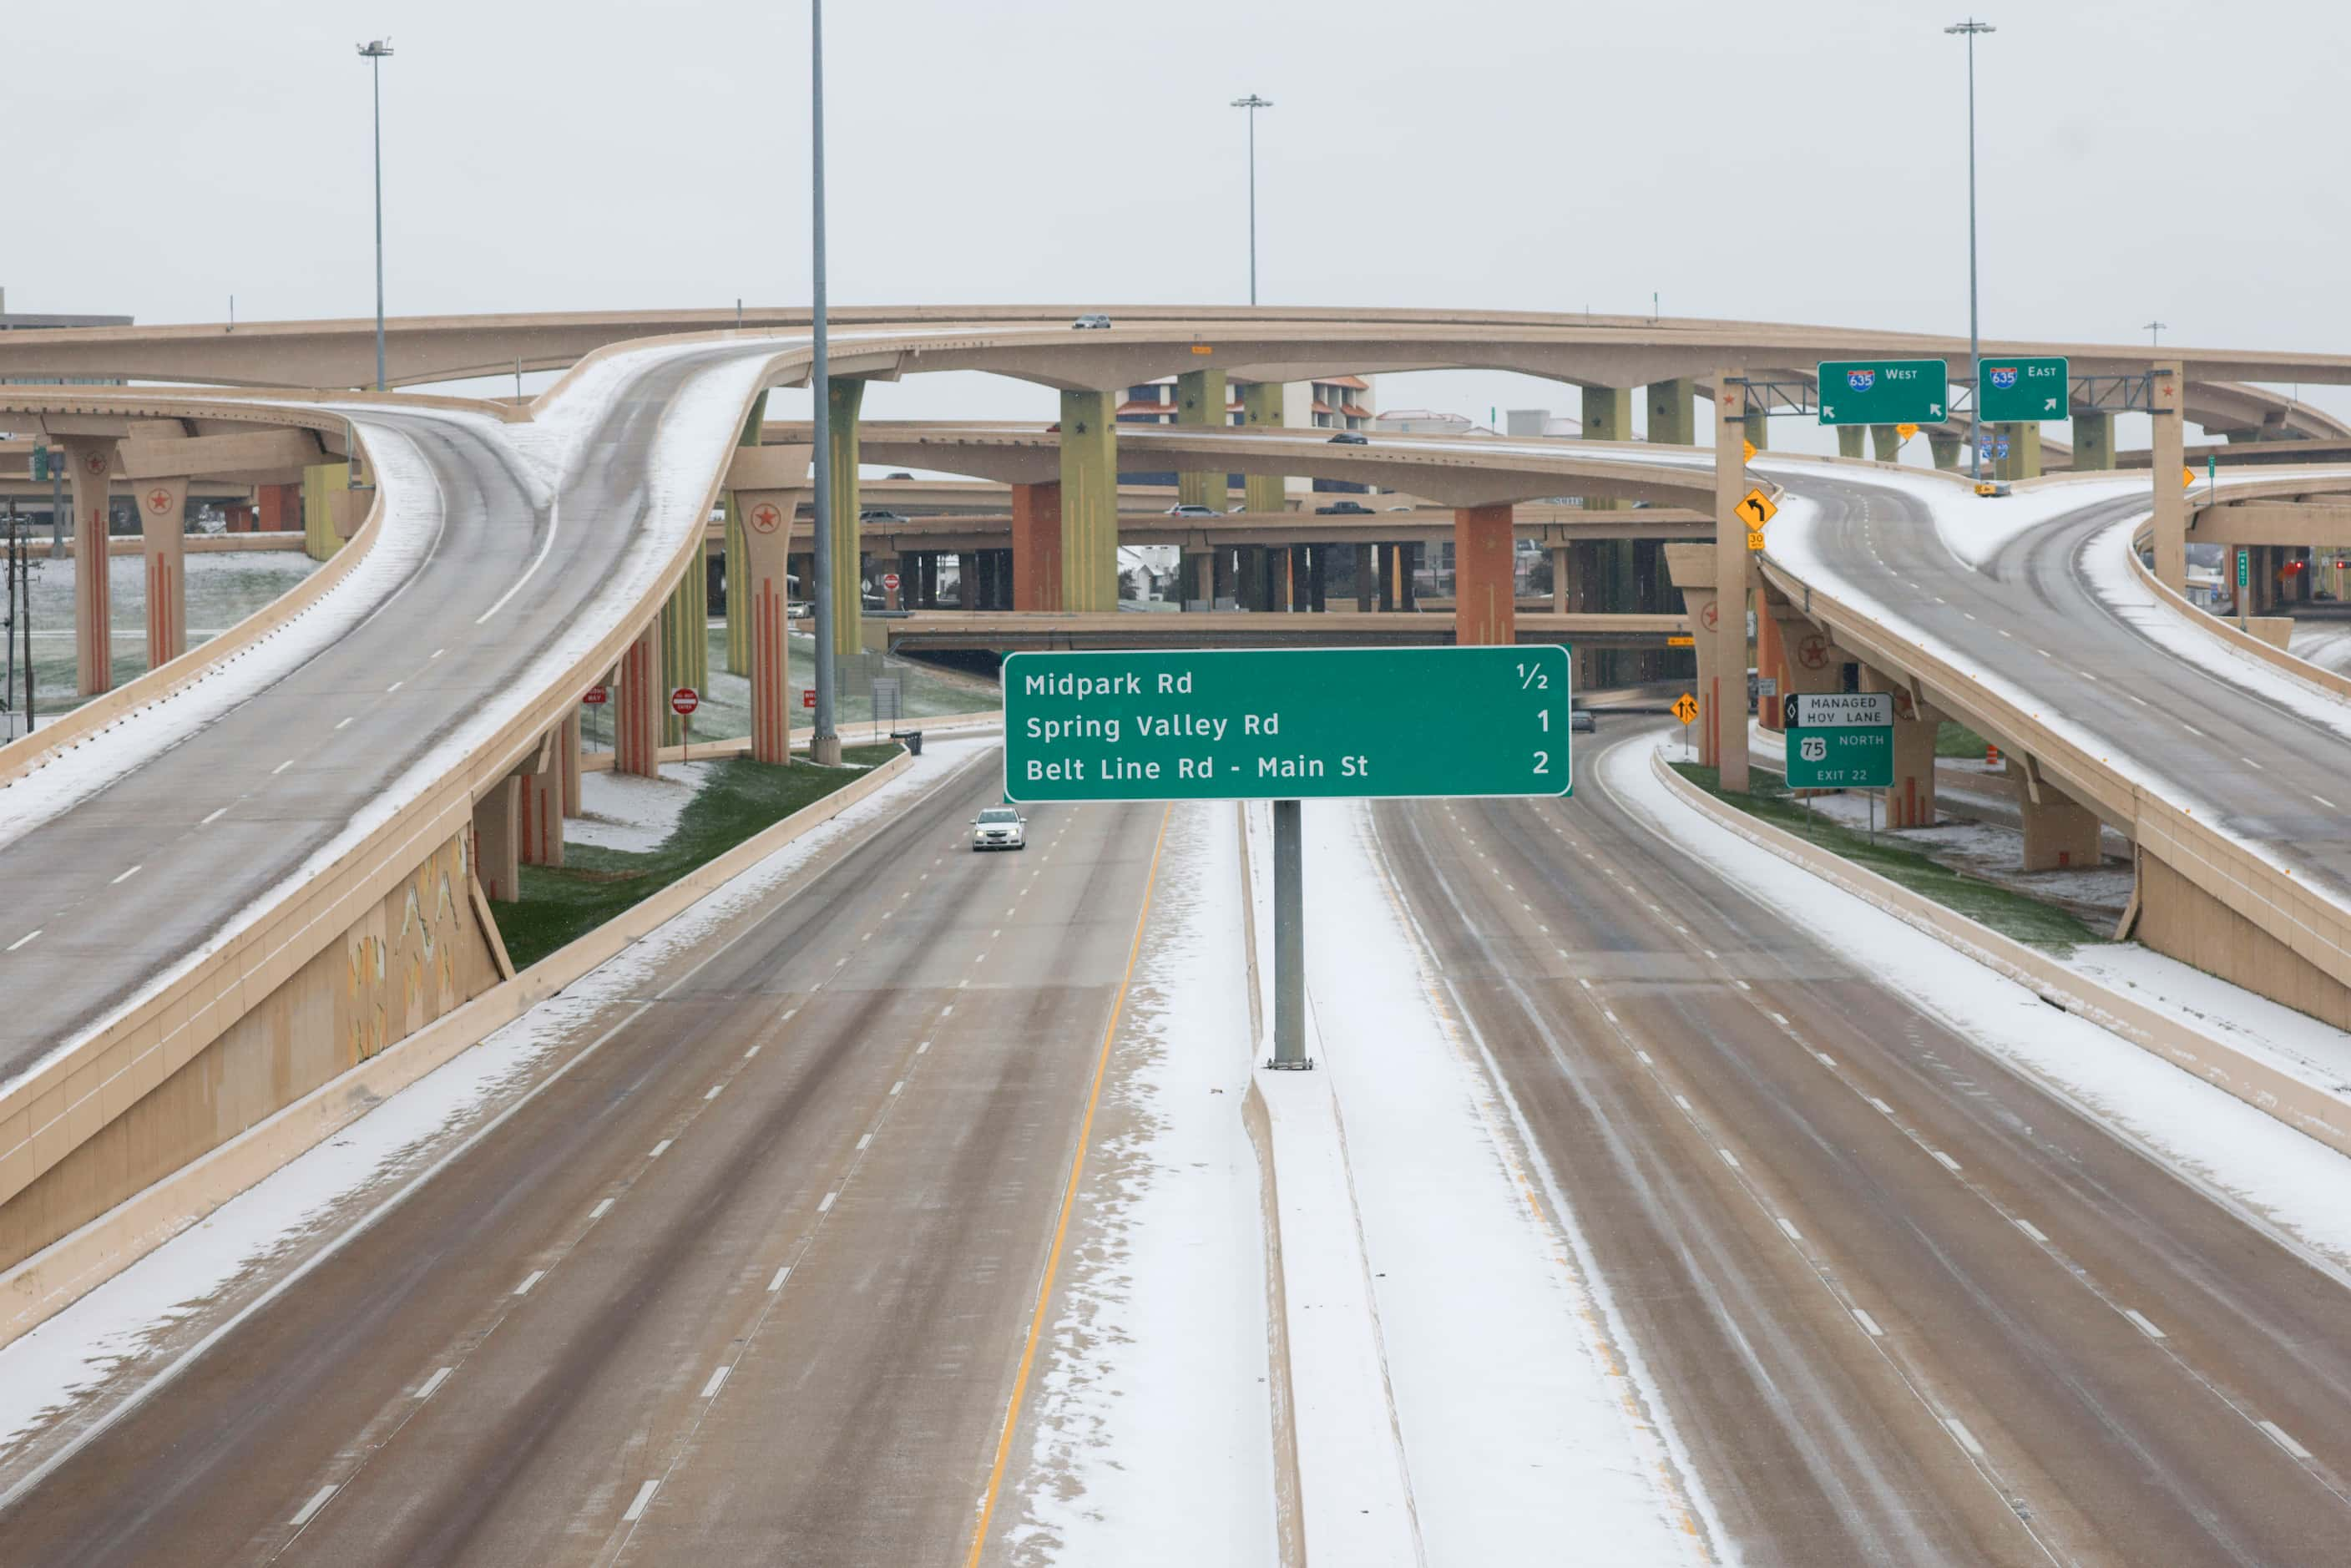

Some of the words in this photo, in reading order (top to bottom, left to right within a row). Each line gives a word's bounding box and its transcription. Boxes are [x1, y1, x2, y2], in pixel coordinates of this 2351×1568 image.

[1885, 368, 1918, 380] WEST
[1992, 372, 2015, 383] 635
[2028, 366, 2056, 377] EAST
[1850, 374, 1872, 386] 635
[1750, 534, 1763, 543] 30
[1025, 673, 1141, 701] Midpark
[1157, 671, 1192, 695] Rd
[1811, 697, 1877, 709] MANAGED
[1537, 709, 1549, 732] 1
[1807, 712, 1835, 723] HOV
[1847, 711, 1883, 722] LANE
[1026, 715, 1120, 743] Spring
[1135, 714, 1228, 741] Valley
[1244, 712, 1279, 736] Rd
[1839, 735, 1884, 746] NORTH
[1802, 741, 1823, 756] 75
[1026, 757, 1084, 781] Belt
[1100, 756, 1160, 780] Line
[1178, 756, 1213, 779] Rd
[1257, 754, 1325, 778] Main
[1341, 755, 1368, 777] St
[1533, 751, 1549, 774] 2
[1817, 770, 1844, 781] EXIT
[1852, 770, 1867, 781] 22
